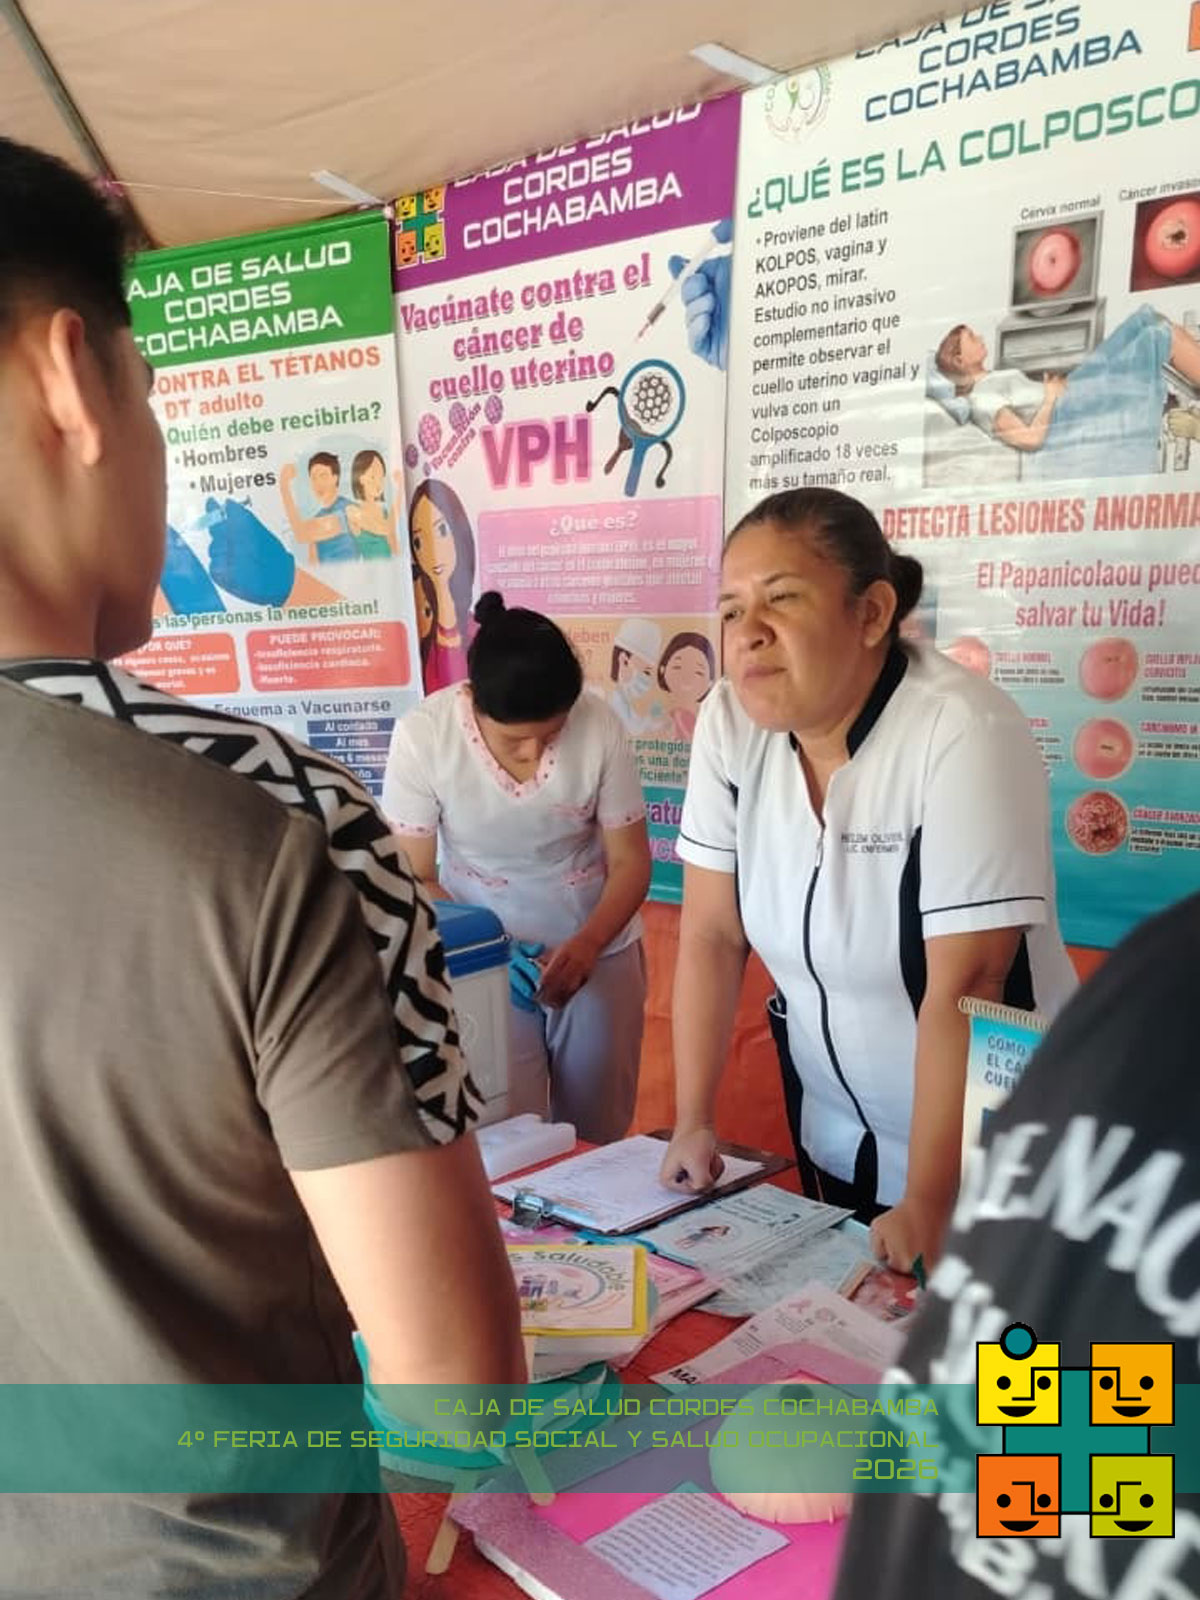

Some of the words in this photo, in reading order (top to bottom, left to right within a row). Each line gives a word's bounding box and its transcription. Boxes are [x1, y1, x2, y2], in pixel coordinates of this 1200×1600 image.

[919, 6, 1080, 73] CORDES
[865, 30, 1142, 122] COCHABAMBA
[748, 160, 830, 218] ¿QUÉ
[841, 154, 885, 191] ES
[897, 141, 945, 180] LA
[959, 79, 1200, 167] COLPOSCO
[504, 146, 632, 206] CORDES
[463, 172, 681, 250] COCHABAMBA
[764, 224, 825, 247] Proviene
[829, 214, 851, 234] del
[127, 272, 183, 302] AJA
[191, 263, 232, 290] DE
[241, 241, 351, 279] SALUD
[755, 247, 820, 274] KOLPOS,
[825, 239, 873, 262] vagina
[878, 237, 888, 256] y
[401, 286, 514, 331] Vacúnate
[521, 264, 615, 308] contra
[623, 252, 651, 290] el
[755, 273, 821, 299] AKOPOS,
[826, 267, 867, 287] mirar.
[165, 281, 292, 323] CORDES
[754, 304, 807, 323] Estudio
[811, 301, 829, 313] no
[834, 288, 896, 311] invasivo
[453, 322, 544, 361] cáncer
[549, 311, 583, 343] de
[754, 318, 867, 348] complementario
[873, 315, 900, 336] que
[150, 368, 230, 396] ONTRA
[238, 363, 264, 383] EL
[270, 346, 381, 378] TÉTANOS
[753, 351, 805, 375] permite
[809, 344, 872, 366] observar
[878, 339, 891, 355] el
[429, 361, 504, 401] cuello
[511, 350, 615, 394] uterino
[752, 376, 794, 396] cuello
[798, 370, 848, 391] uterino
[852, 364, 906, 387] vaginal
[910, 365, 921, 381] y
[164, 398, 190, 420] DT
[200, 393, 264, 416] adulto
[227, 417, 274, 439] debe
[281, 401, 382, 430] recibirla?
[752, 400, 788, 419] vulva
[792, 399, 817, 415] con
[822, 397, 841, 412] un
[751, 422, 839, 444] Colposcopio
[182, 445, 268, 468] Hombres
[481, 414, 591, 490] VPH
[750, 446, 830, 469] amplificado
[836, 443, 851, 459] 18
[855, 442, 898, 458] veces
[200, 471, 277, 494] Mujeres
[782, 475, 799, 488] su
[803, 468, 855, 486] tamaño
[860, 464, 892, 482] real.
[882, 503, 971, 540] DETECTA
[978, 497, 1084, 537] LESIONES
[1093, 491, 1200, 531] ANORMA
[977, 562, 993, 588] El
[1000, 557, 1142, 594] Papanicolaou
[165, 614, 188, 628] las
[191, 611, 262, 630] personas
[267, 606, 283, 622] la
[288, 600, 379, 621] necesitan!
[1015, 600, 1075, 627] salvar
[1081, 600, 1102, 627] tu
[1108, 599, 1166, 628] Vida!
[567, 626, 611, 644] eben
[288, 704, 297, 715] a
[301, 700, 391, 715] Vacunarse
[986, 1052, 1000, 1068] EL
[987, 1034, 1026, 1057] COMO
